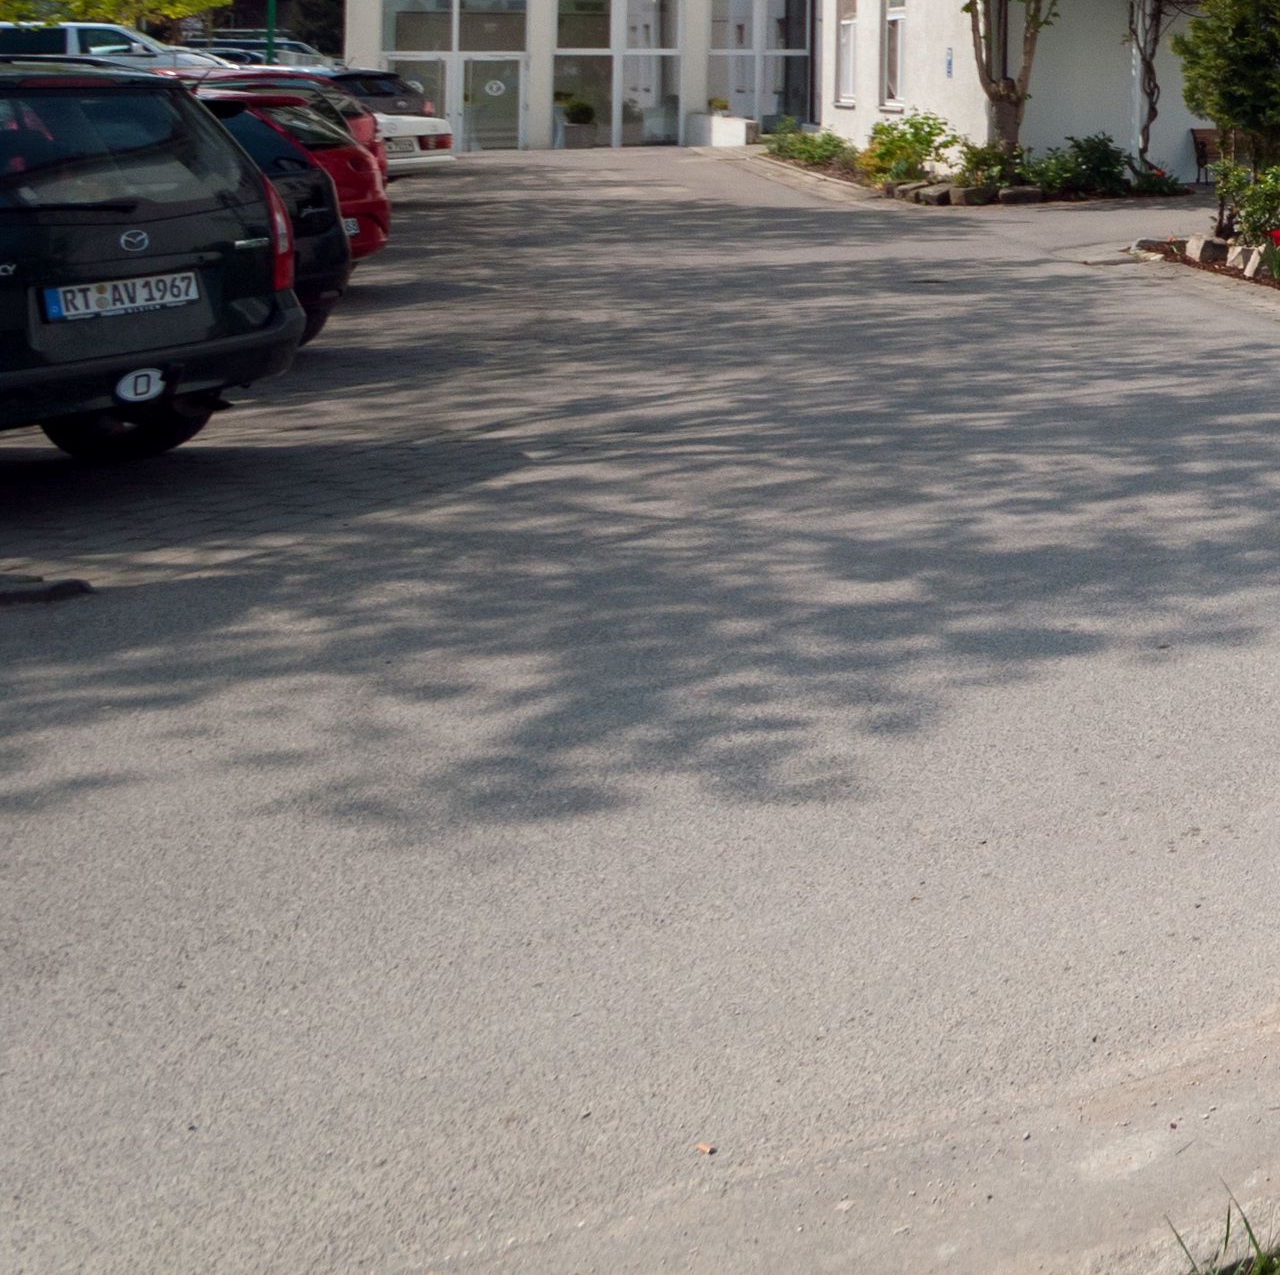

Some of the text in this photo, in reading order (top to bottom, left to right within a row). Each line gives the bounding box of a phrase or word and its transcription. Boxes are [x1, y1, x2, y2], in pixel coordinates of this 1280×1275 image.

[61, 287, 91, 313] RT
[111, 282, 137, 307] AV
[142, 276, 193, 302] 1967
[134, 374, 151, 397] D
